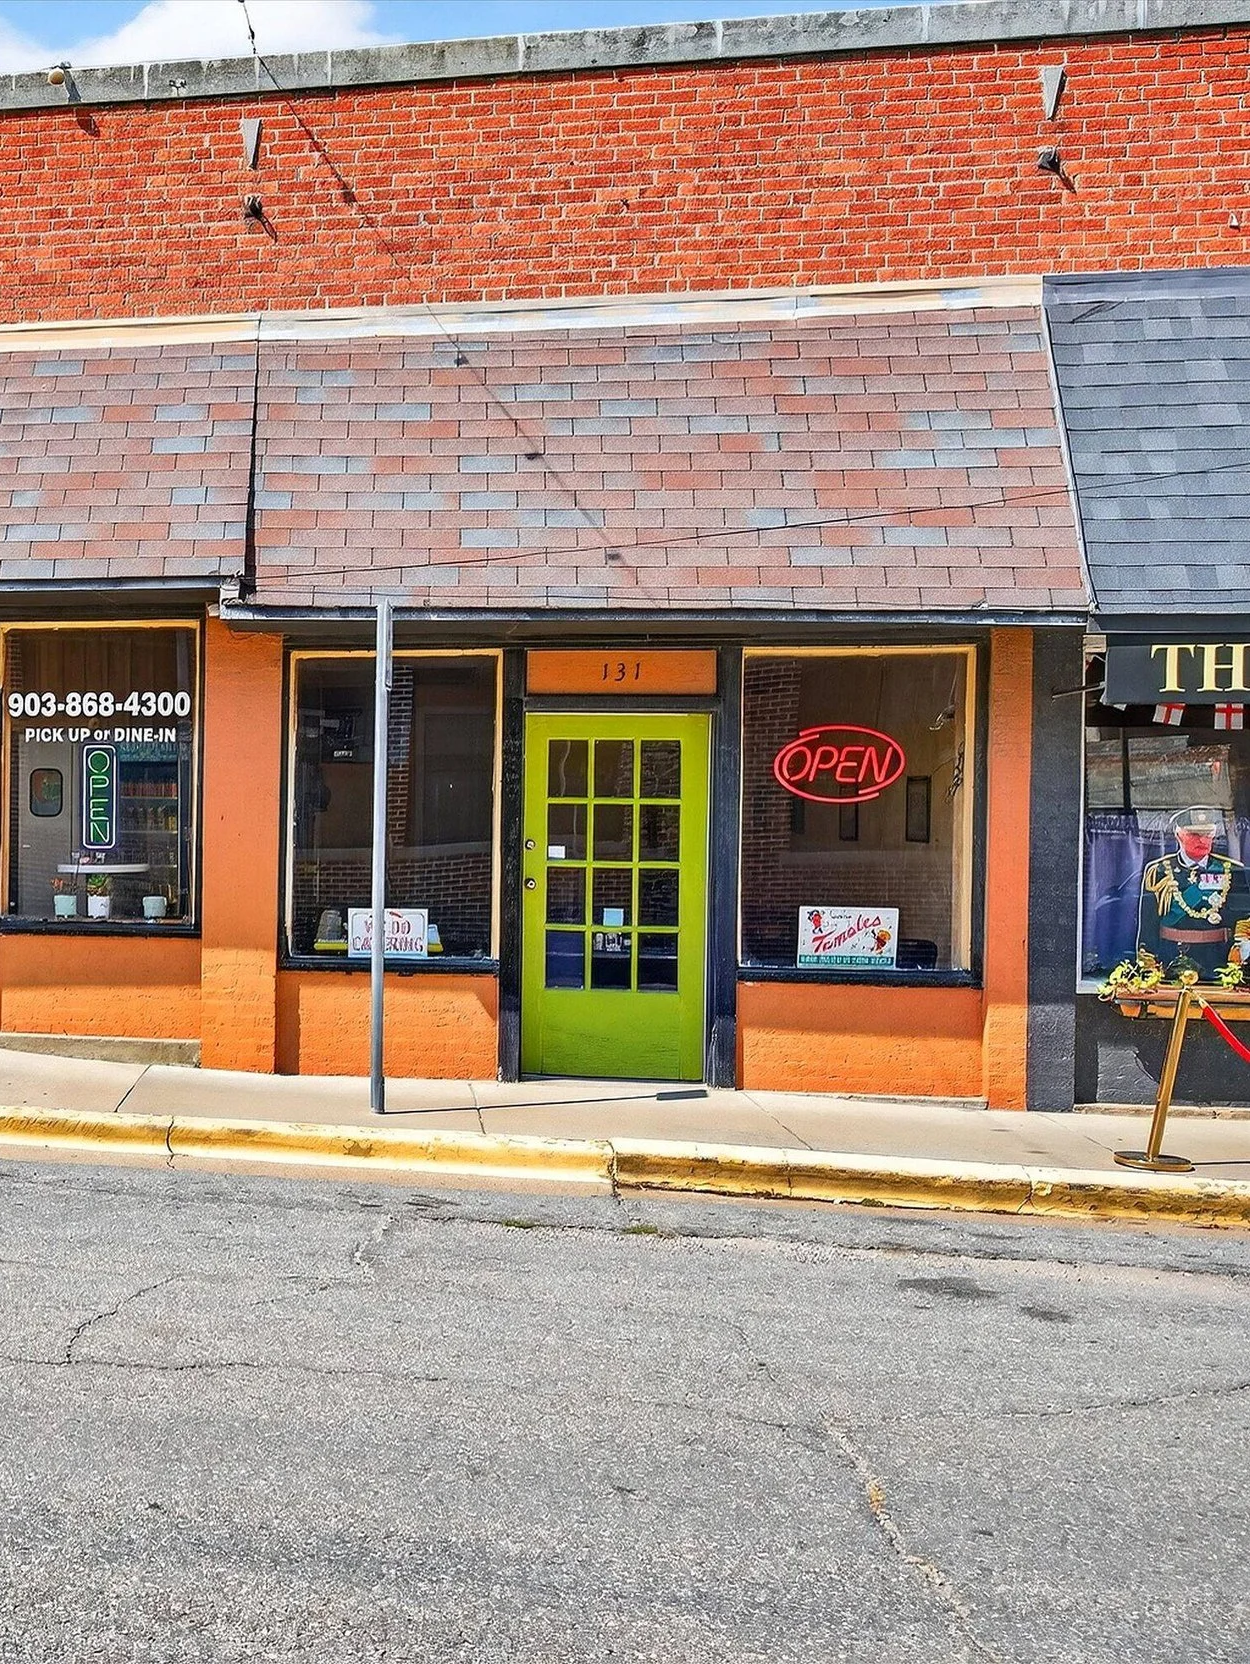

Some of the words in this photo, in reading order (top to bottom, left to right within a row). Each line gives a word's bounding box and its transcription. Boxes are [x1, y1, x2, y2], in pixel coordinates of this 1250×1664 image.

[602, 662, 641, 682] 131
[7, 691, 191, 718] 903-868-4300
[25, 728, 64, 743] PICK
[68, 728, 91, 743] UP
[93, 728, 111, 743] or
[113, 727, 177, 743] DINE-IN
[781, 744, 893, 783] OPEN
[87, 750, 111, 844] OPEN
[391, 919, 411, 936] DO
[352, 936, 424, 953] CAERING
